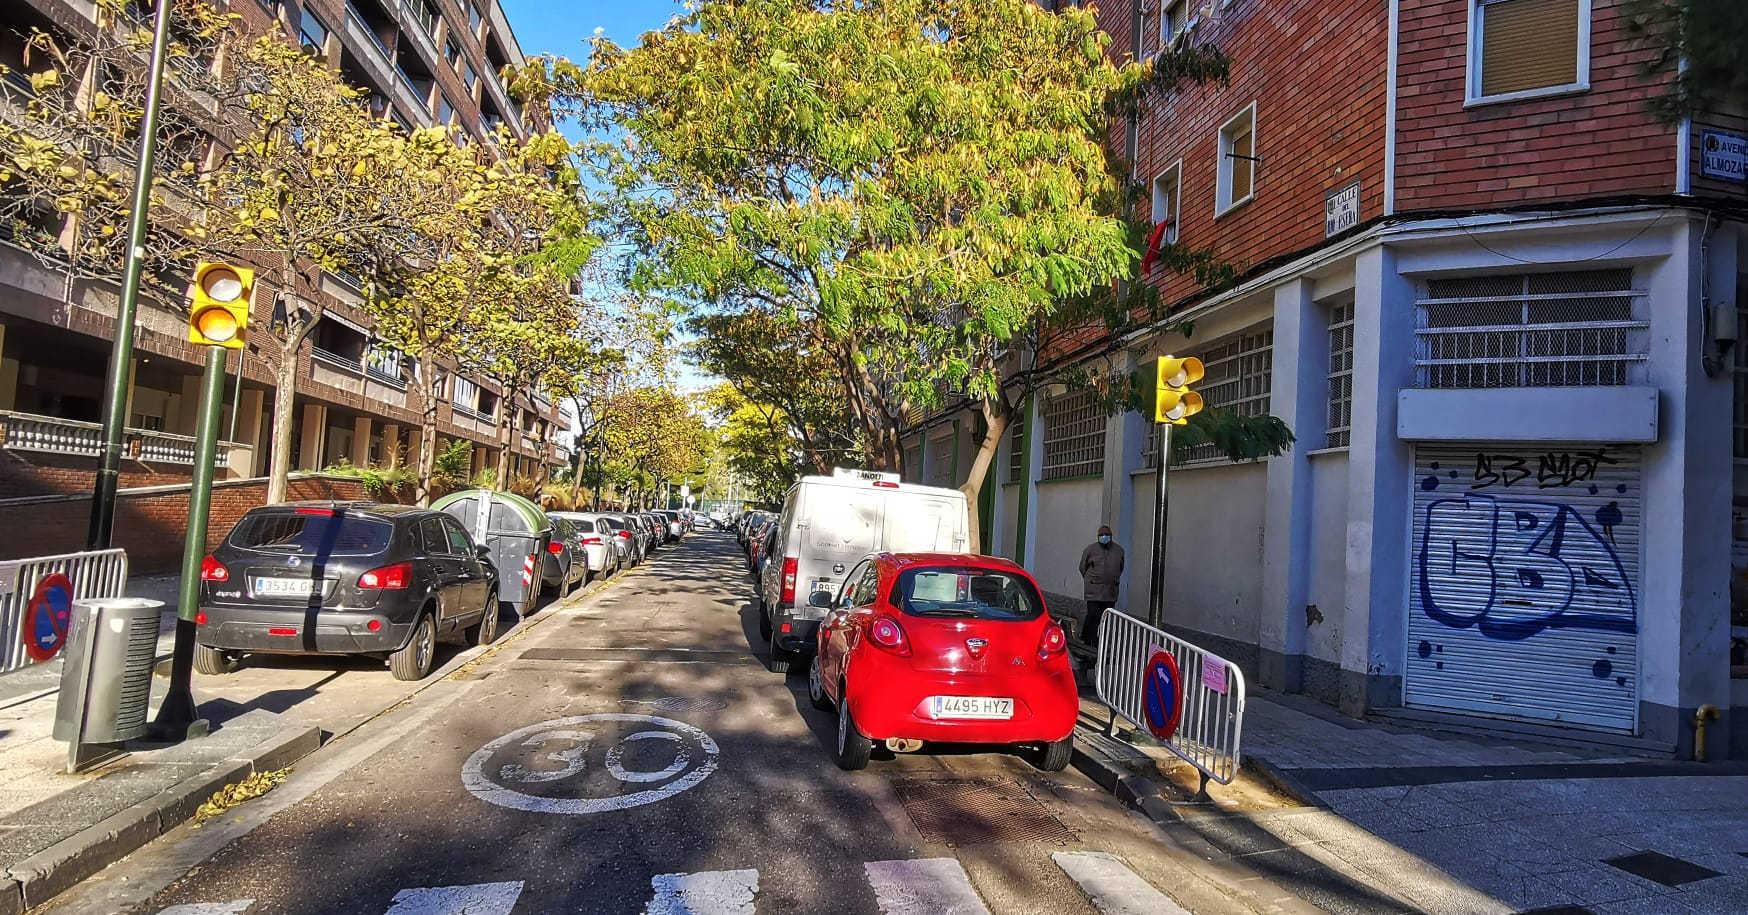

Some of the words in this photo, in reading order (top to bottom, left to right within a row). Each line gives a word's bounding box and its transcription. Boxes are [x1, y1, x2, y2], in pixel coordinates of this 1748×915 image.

[1337, 187, 1356, 206] CALLE
[265, 580, 296, 592] 3534
[944, 698, 979, 713] 4495
[983, 700, 1009, 714] HYZ
[500, 729, 690, 784] 30
